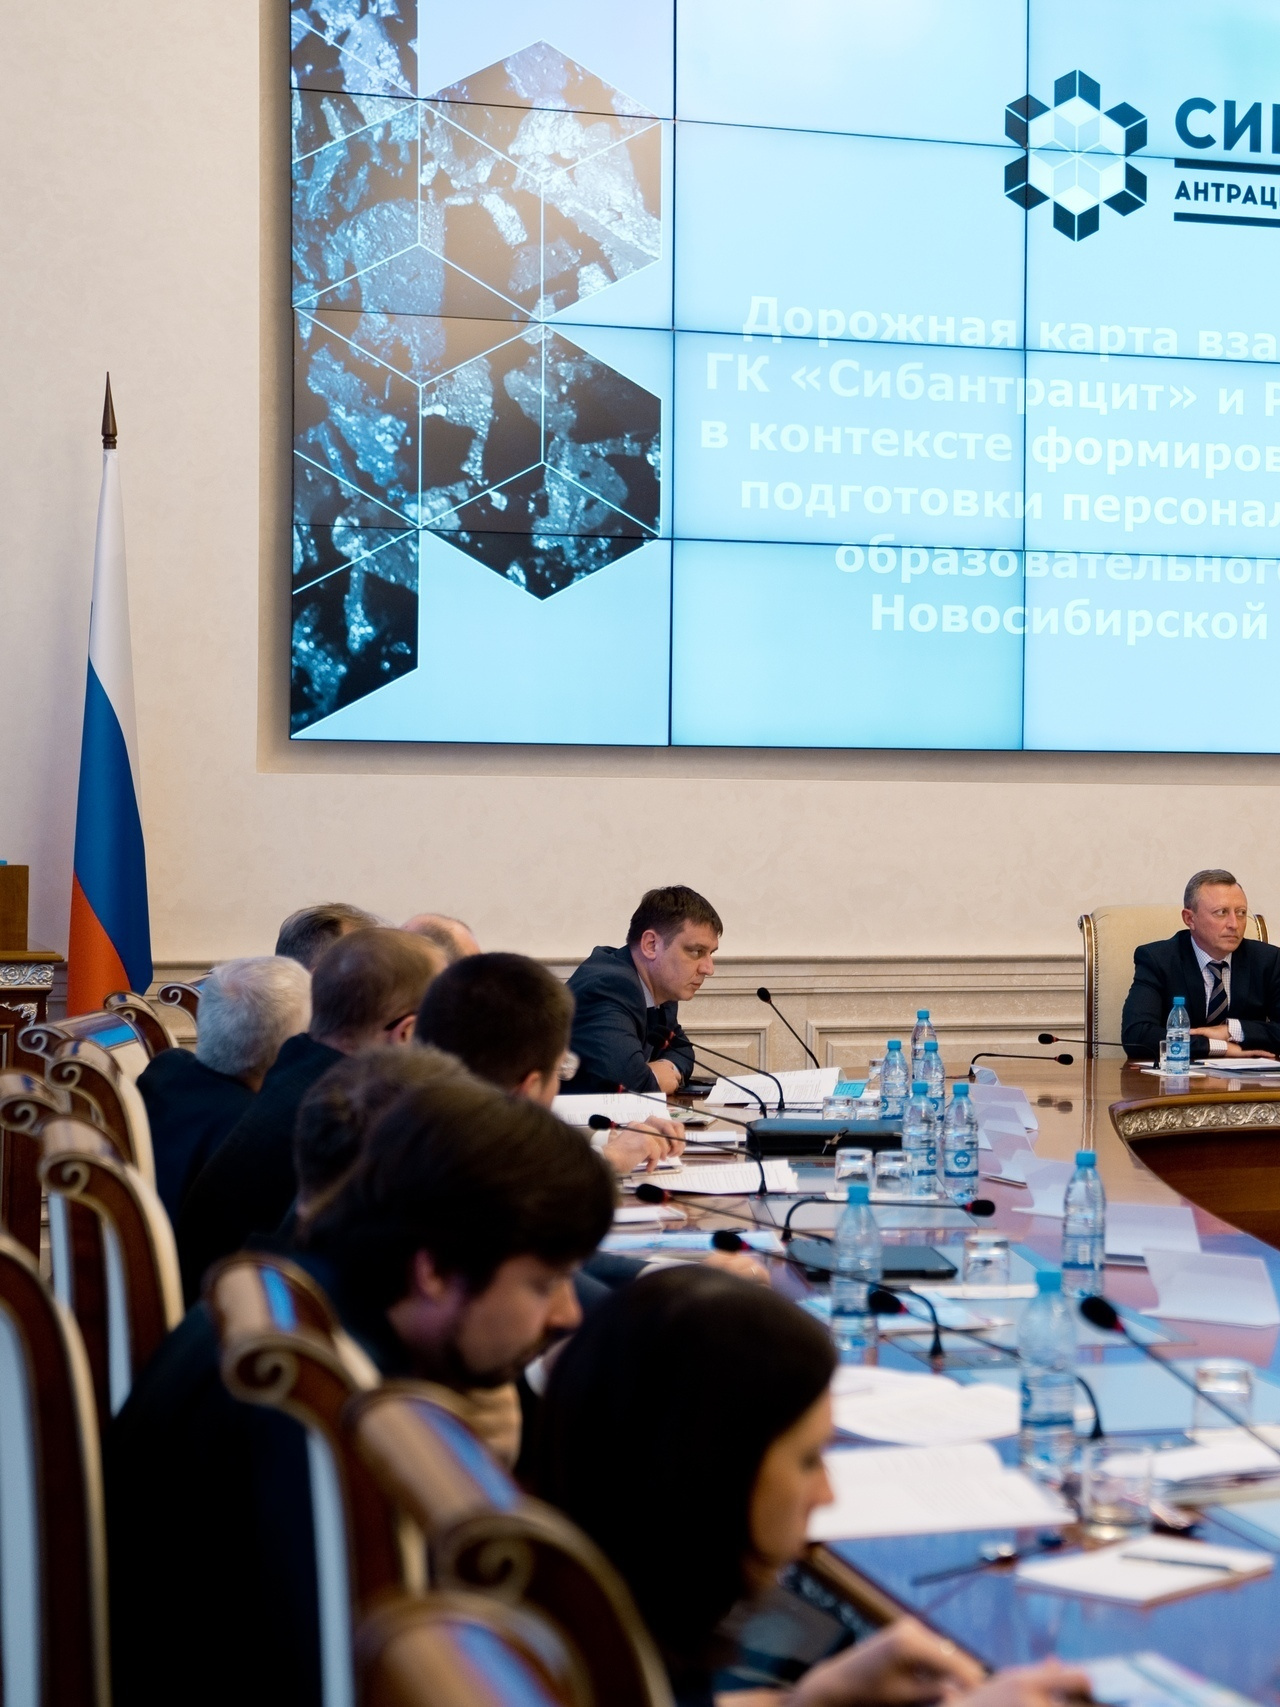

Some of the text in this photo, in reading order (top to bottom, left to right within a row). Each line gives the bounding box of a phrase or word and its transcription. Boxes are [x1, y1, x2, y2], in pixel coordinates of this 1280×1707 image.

[742, 296, 1017, 347] Дорожная
[1040, 320, 1178, 362] карта
[706, 352, 770, 392] ГК
[791, 359, 1197, 415] «Сибантрацит»
[1218, 387, 1244, 416] и
[701, 421, 729, 449] в
[750, 422, 1012, 462] контексте
[741, 481, 1042, 519] подготовки
[871, 594, 1267, 645] Новосибирской
